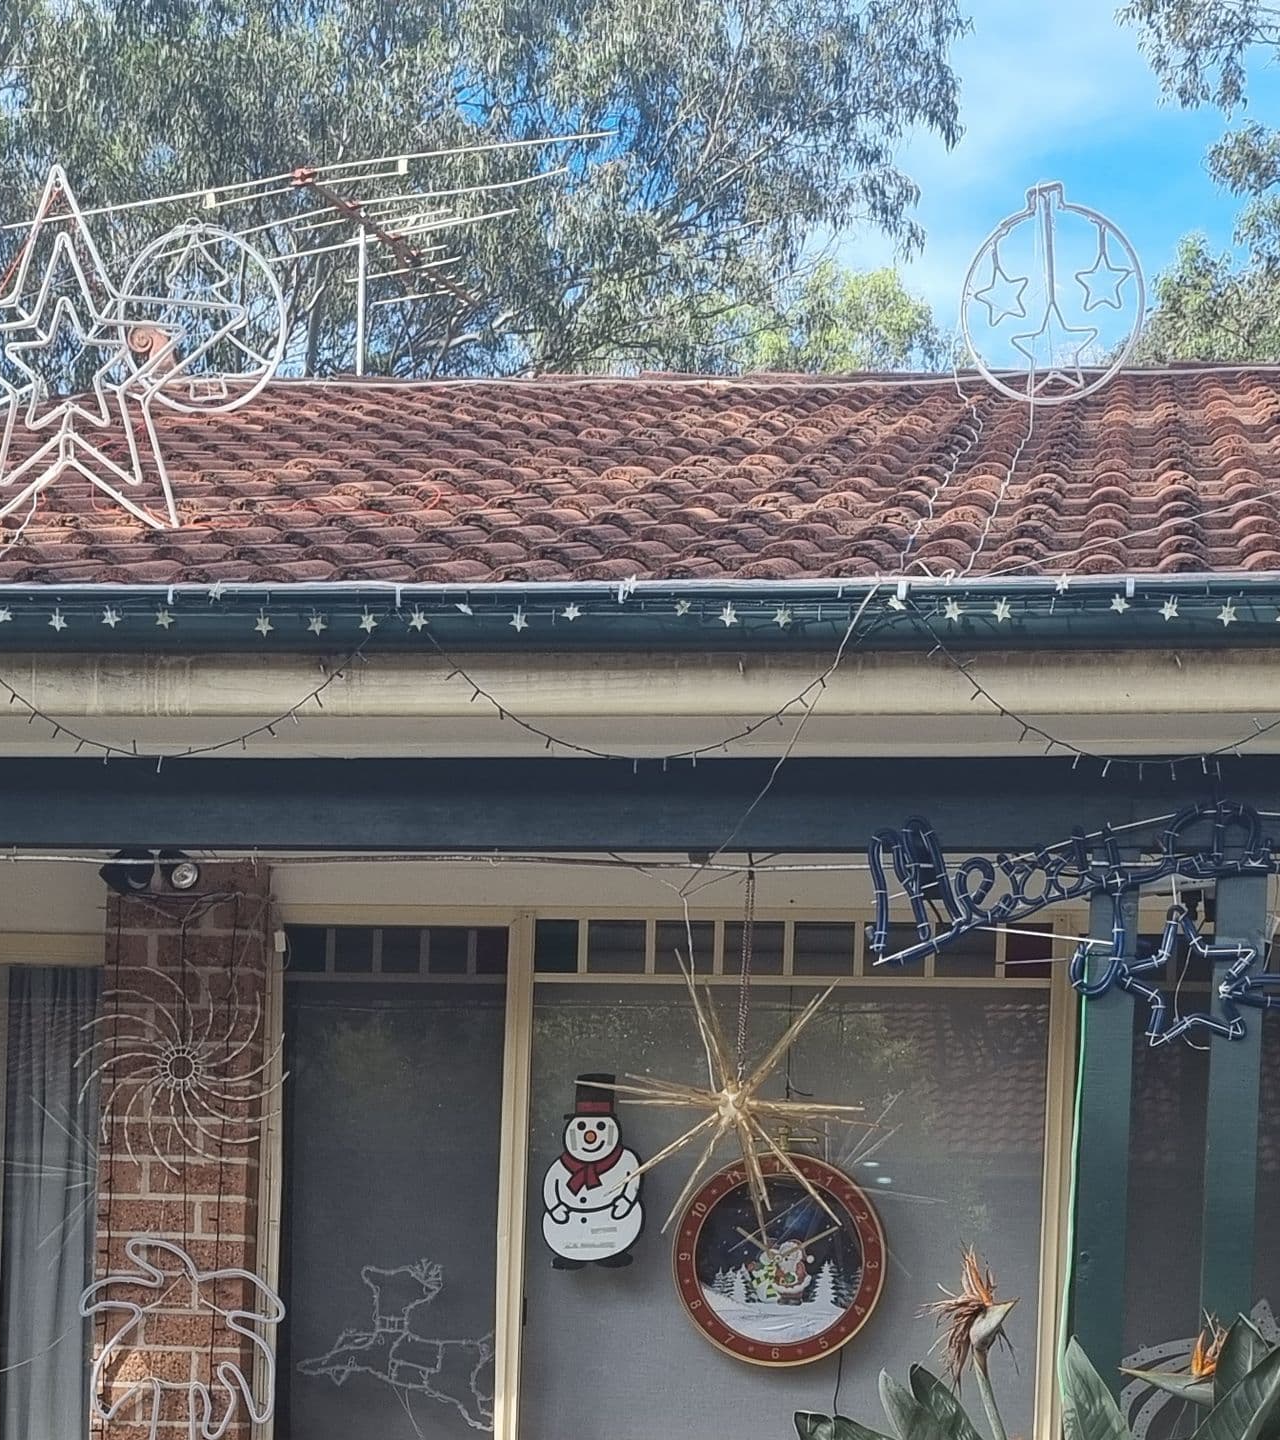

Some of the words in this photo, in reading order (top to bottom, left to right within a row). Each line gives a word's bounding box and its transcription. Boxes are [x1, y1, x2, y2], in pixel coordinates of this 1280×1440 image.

[726, 1171, 742, 1185] 11
[692, 1202, 707, 1218] 10
[856, 1212, 868, 1223] 2
[679, 1253, 691, 1261] 9
[866, 1261, 879, 1269] 3
[690, 1300, 702, 1309] 8
[855, 1305, 866, 1316] 4
[724, 1334, 735, 1344] 7
[819, 1338, 829, 1349] 5
[771, 1347, 780, 1359] 6
